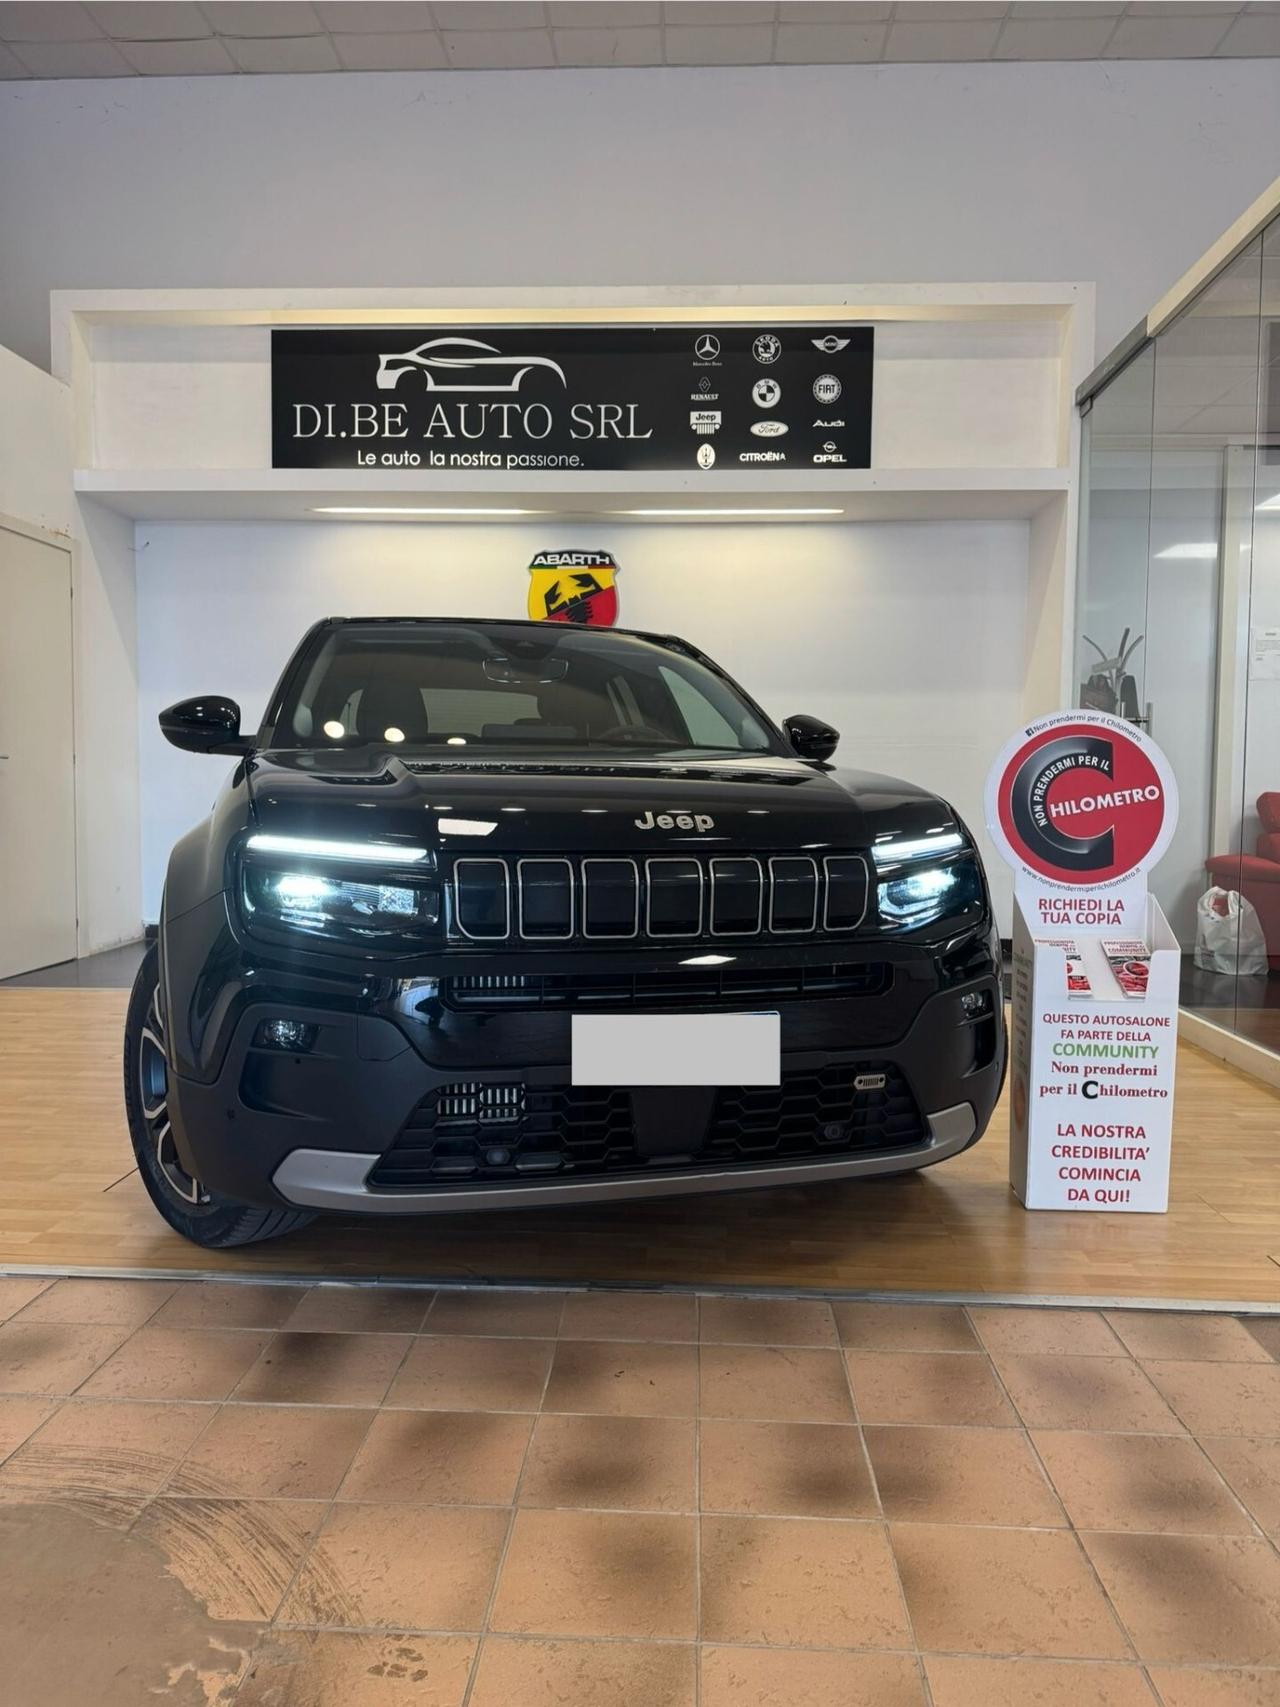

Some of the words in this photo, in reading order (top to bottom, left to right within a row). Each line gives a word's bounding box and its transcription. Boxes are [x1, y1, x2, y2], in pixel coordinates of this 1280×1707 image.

[818, 384, 836, 394] FIAT
[292, 403, 409, 438] DI.BE
[423, 403, 552, 439] AUTO
[569, 403, 653, 439] SRL
[695, 413, 716, 422] Jeep
[813, 419, 845, 427] Audi
[758, 424, 780, 433] Ford
[358, 450, 376, 465] Le
[381, 451, 421, 466] auto
[429, 450, 447, 466] la
[450, 451, 502, 466] nostra
[507, 451, 584, 469] passione.
[813, 454, 847, 463] OPEL
[533, 553, 609, 565] ABARTH
[1034, 721, 1048, 732] Non
[1049, 714, 1086, 728] prendermi
[1087, 715, 1099, 723] per
[1106, 718, 1142, 743] Chilometro
[1078, 755, 1098, 766] PER
[1100, 760, 1110, 771] IL
[1034, 757, 1075, 802] PRENDERMI
[634, 811, 715, 832] Jeep
[1034, 805, 1048, 827] NON
[1038, 898, 1102, 911] RICHIEDI
[1107, 899, 1125, 912] LA
[1040, 912, 1071, 924] TUA
[1075, 913, 1122, 925] COPIA
[1042, 1013, 1089, 1024] QUESTO
[1092, 1014, 1170, 1027] AUTOSALONE
[1061, 1029, 1074, 1040] FA
[1077, 1030, 1113, 1041] PARTE
[1116, 1031, 1151, 1042] DELLA
[1052, 1043, 1159, 1059] COMMUNITY
[1052, 1061, 1079, 1074] Non
[1083, 1063, 1158, 1077] prendermi
[1040, 1085, 1063, 1097] per
[1067, 1083, 1077, 1095] il
[1081, 1080, 1168, 1100] Chilometro
[1057, 1123, 1076, 1137] LA
[1081, 1124, 1146, 1139] NOSTRA
[1058, 1167, 1141, 1182] COMINCIA
[1067, 1188, 1089, 1201] DA
[1094, 1189, 1130, 1203] QUI!
